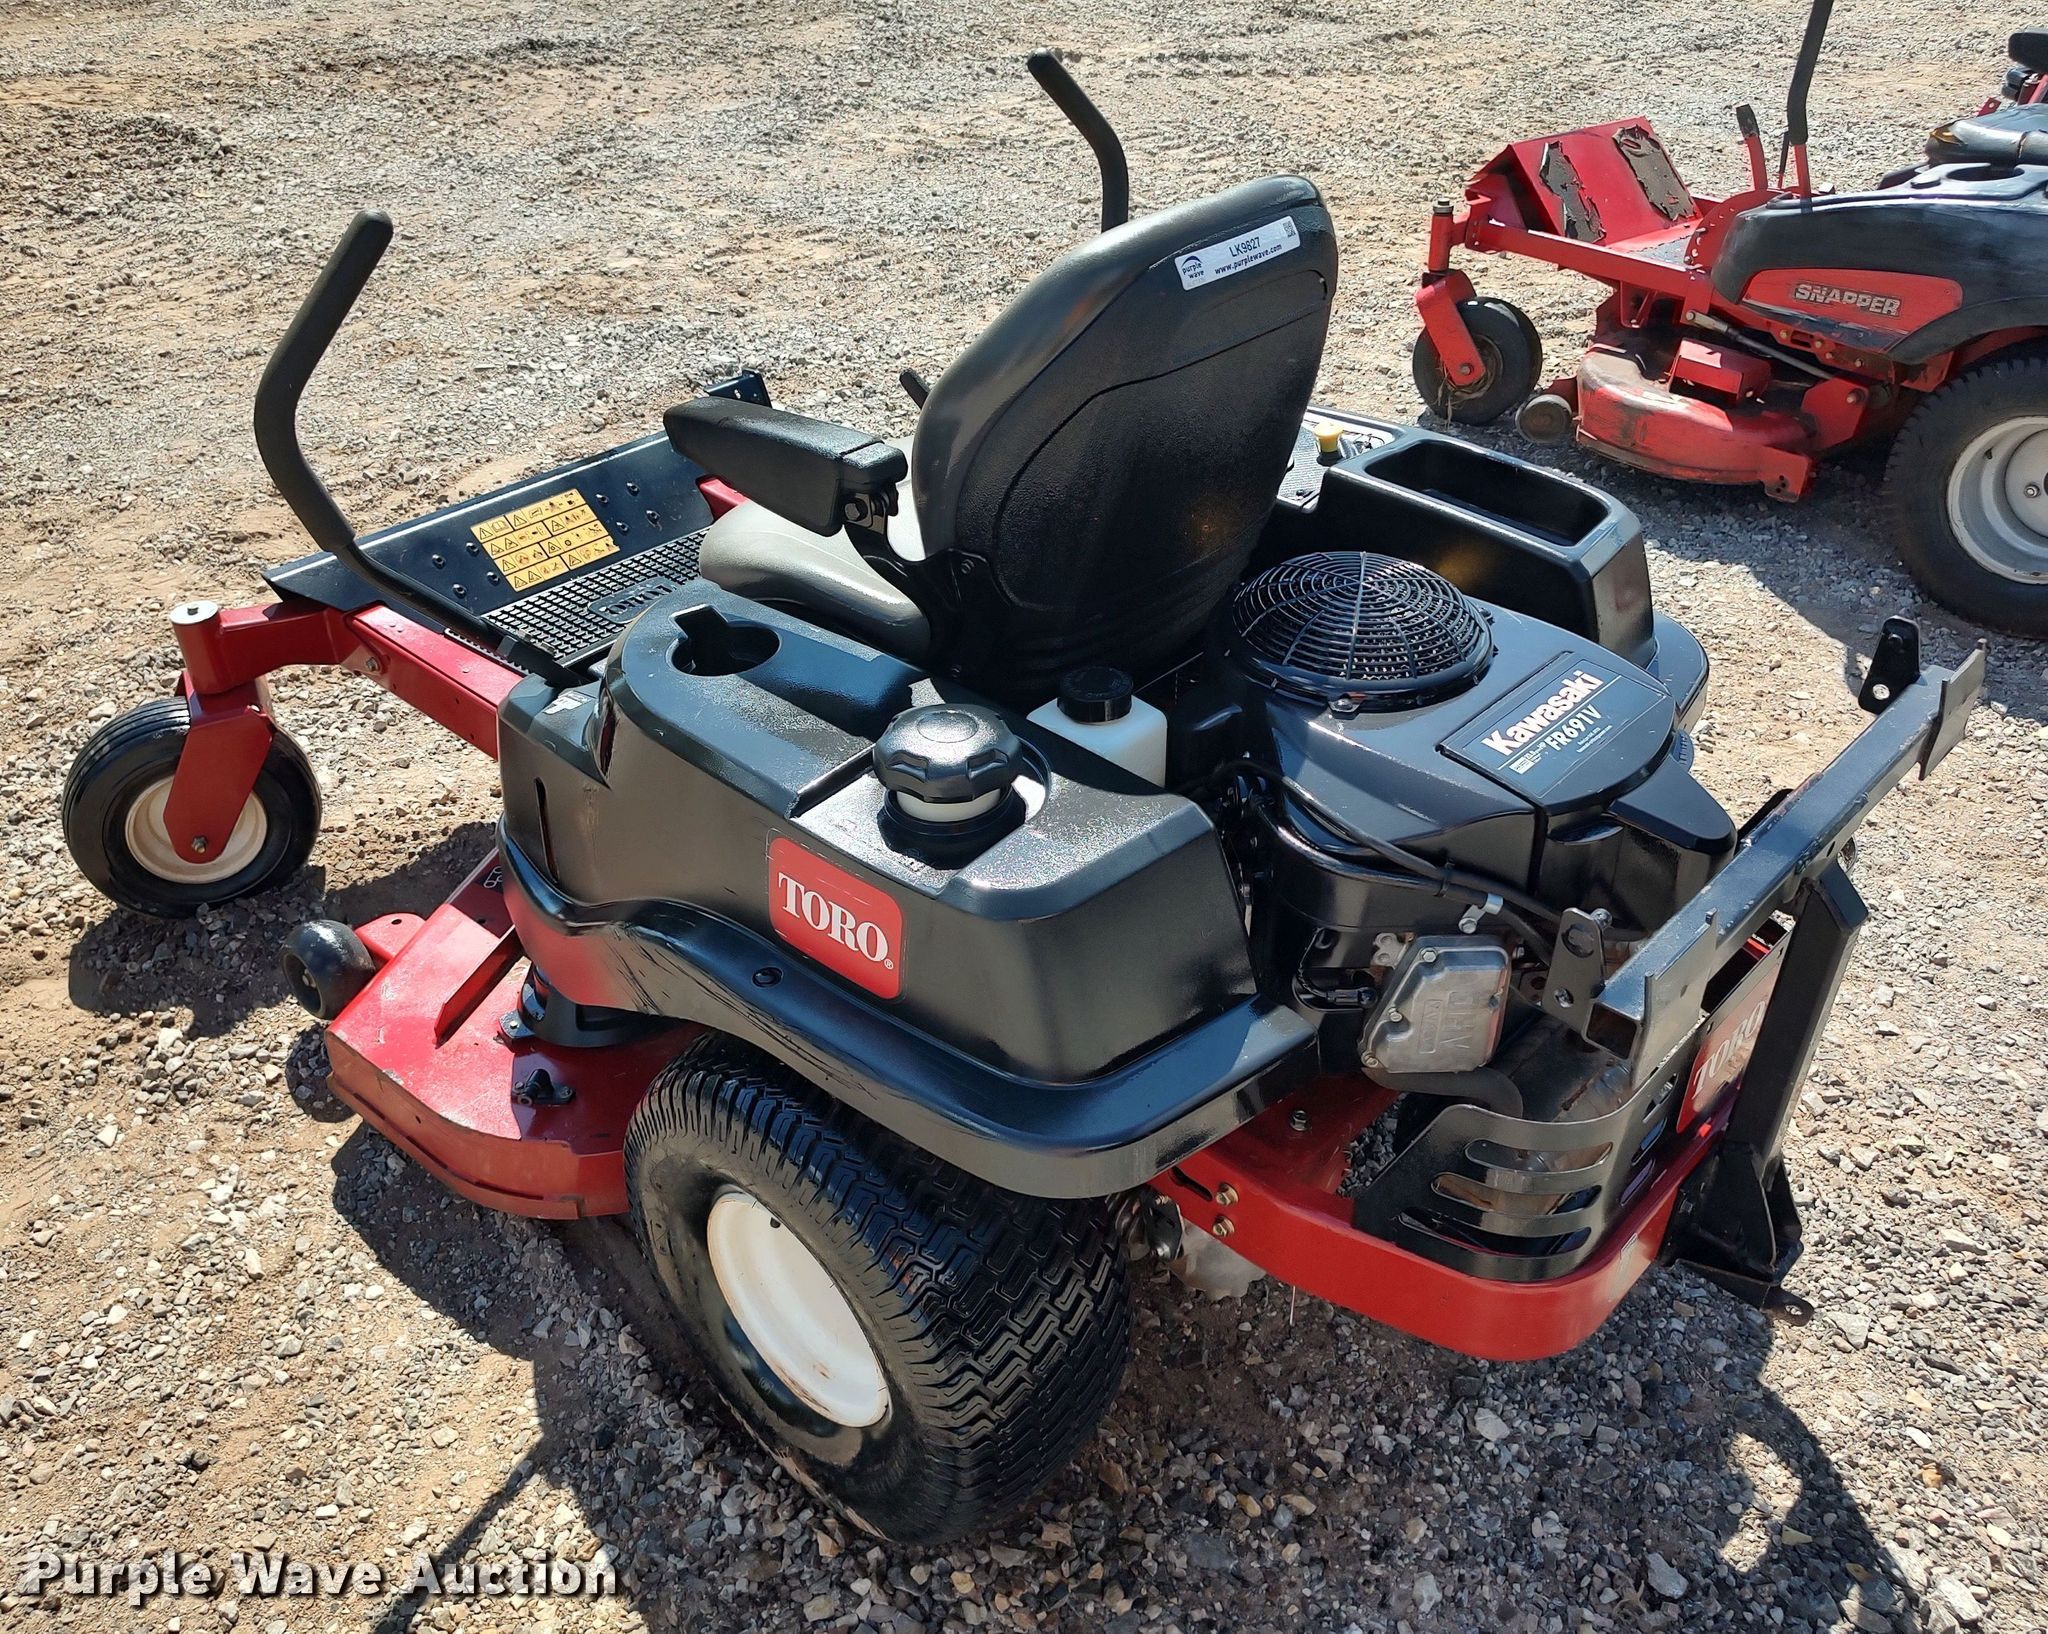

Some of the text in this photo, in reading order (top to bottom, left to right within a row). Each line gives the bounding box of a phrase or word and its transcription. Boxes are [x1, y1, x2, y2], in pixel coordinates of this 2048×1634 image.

[1214, 244, 1283, 275] www.purplewave.com
[1229, 237, 1261, 257] LK9827
[1182, 262, 1202, 275] purple
[1188, 270, 1204, 279] wave
[1795, 283, 1901, 316] SNAPPER
[1481, 670, 1604, 756] Kawasaki
[1544, 703, 1602, 751] FR691V
[778, 872, 888, 962] TORO
[1692, 1000, 1766, 1100] TORO
